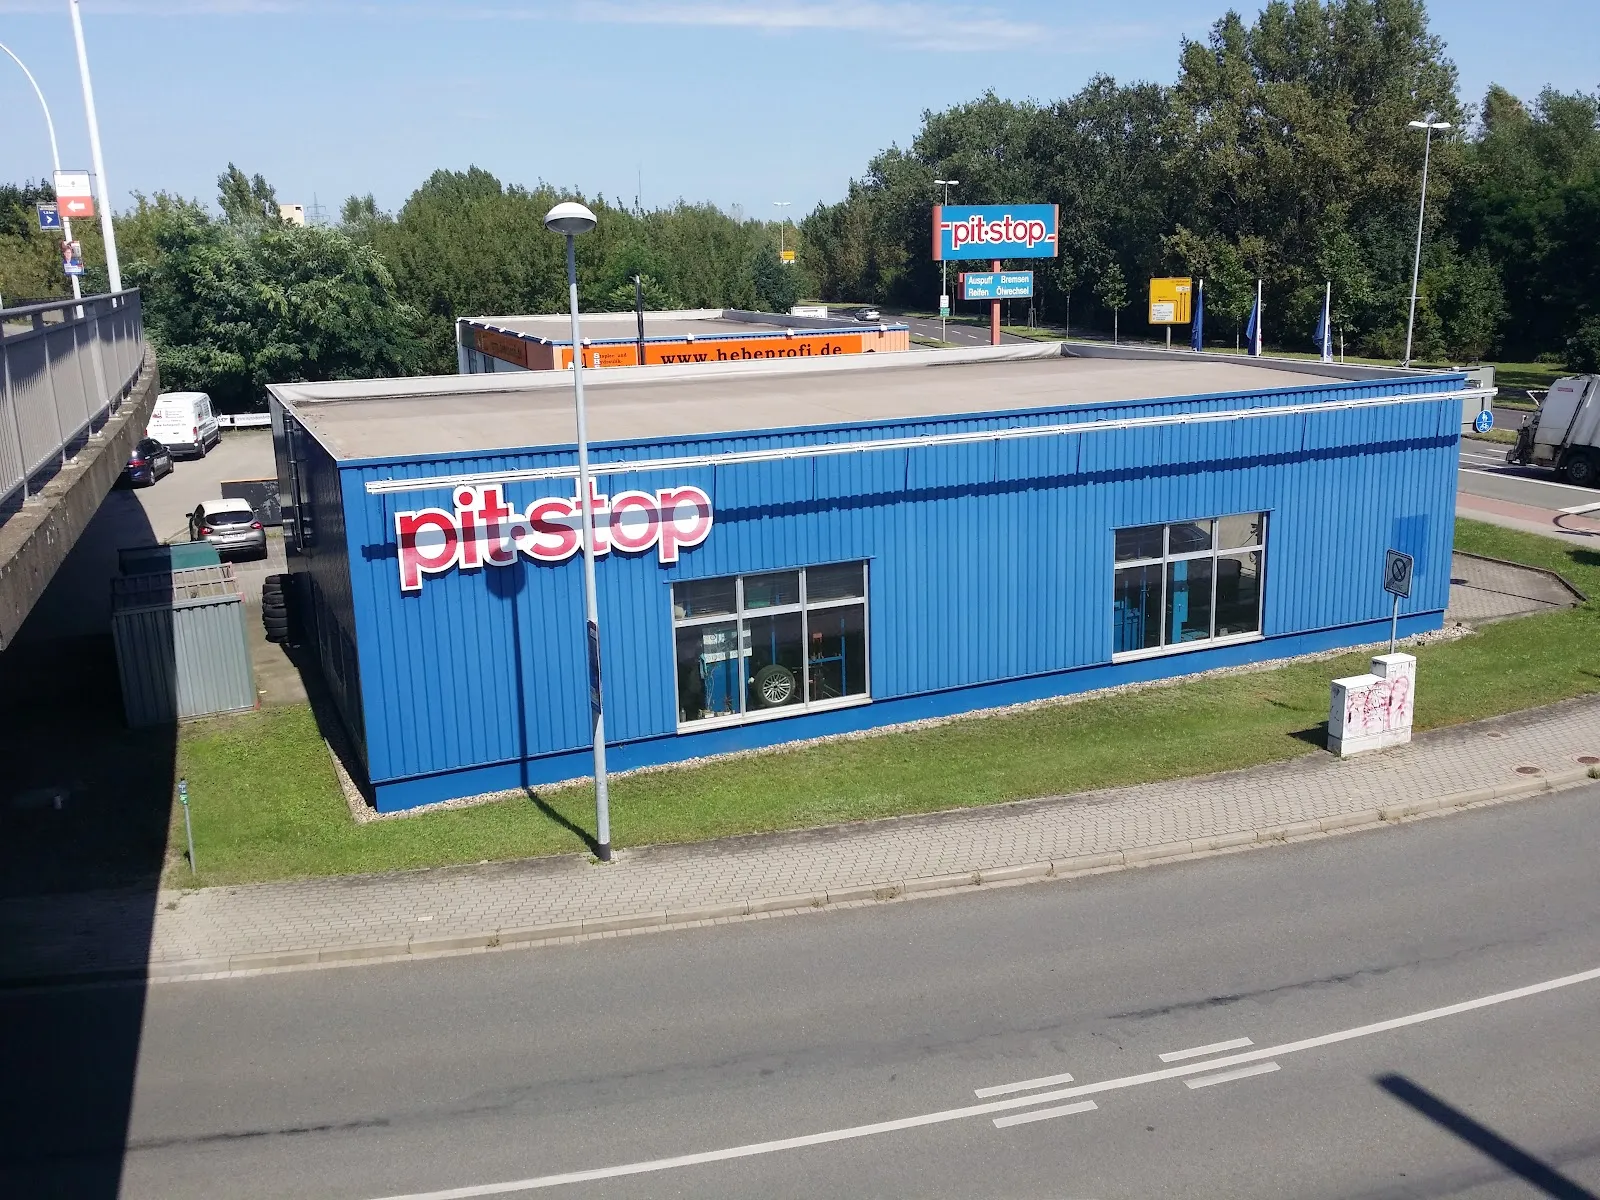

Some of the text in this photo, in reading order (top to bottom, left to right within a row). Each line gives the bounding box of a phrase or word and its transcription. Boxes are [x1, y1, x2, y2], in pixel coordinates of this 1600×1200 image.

[968, 275, 1029, 286] Auspuff Bremsen
[968, 286, 1029, 297] Reifen Ölwechsel
